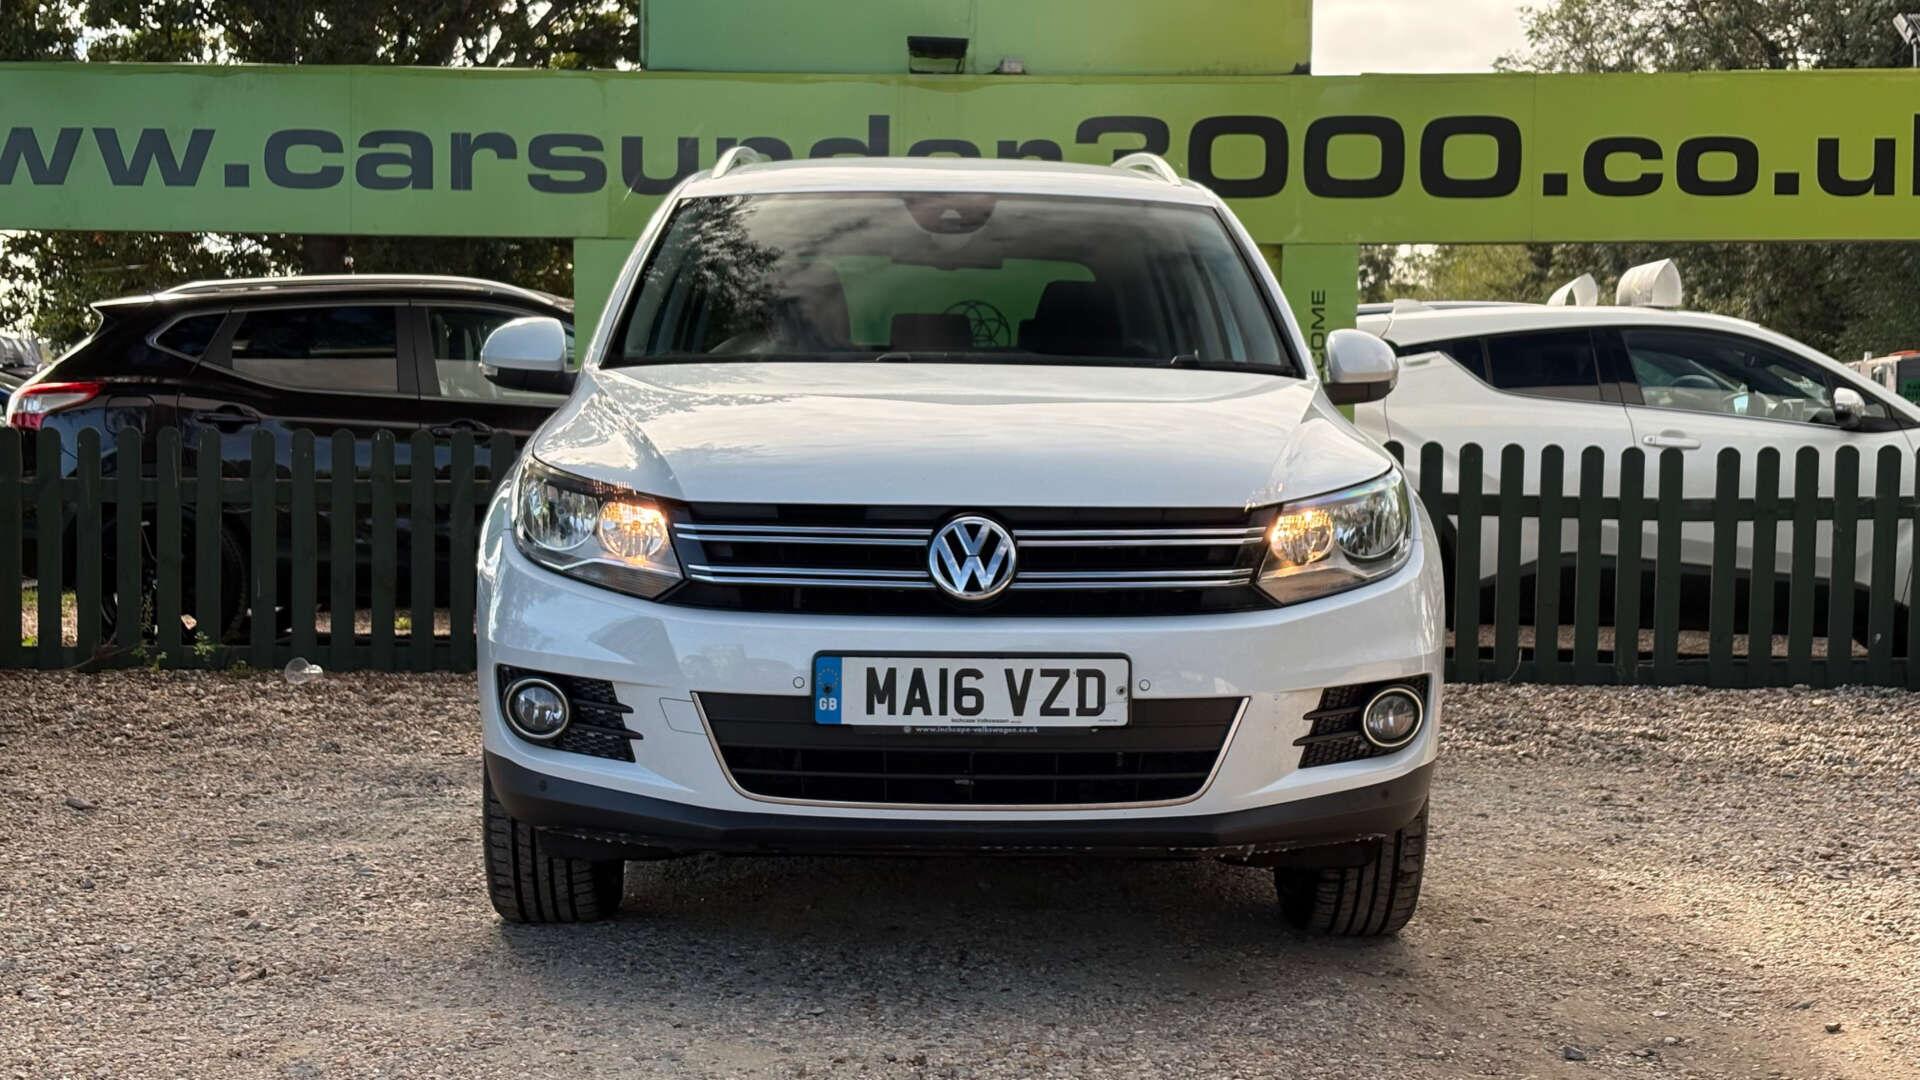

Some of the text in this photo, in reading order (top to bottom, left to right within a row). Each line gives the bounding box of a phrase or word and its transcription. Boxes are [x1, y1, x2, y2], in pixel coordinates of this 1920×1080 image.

[819, 697, 838, 711] GB
[866, 667, 1107, 717] MA16 VZD
